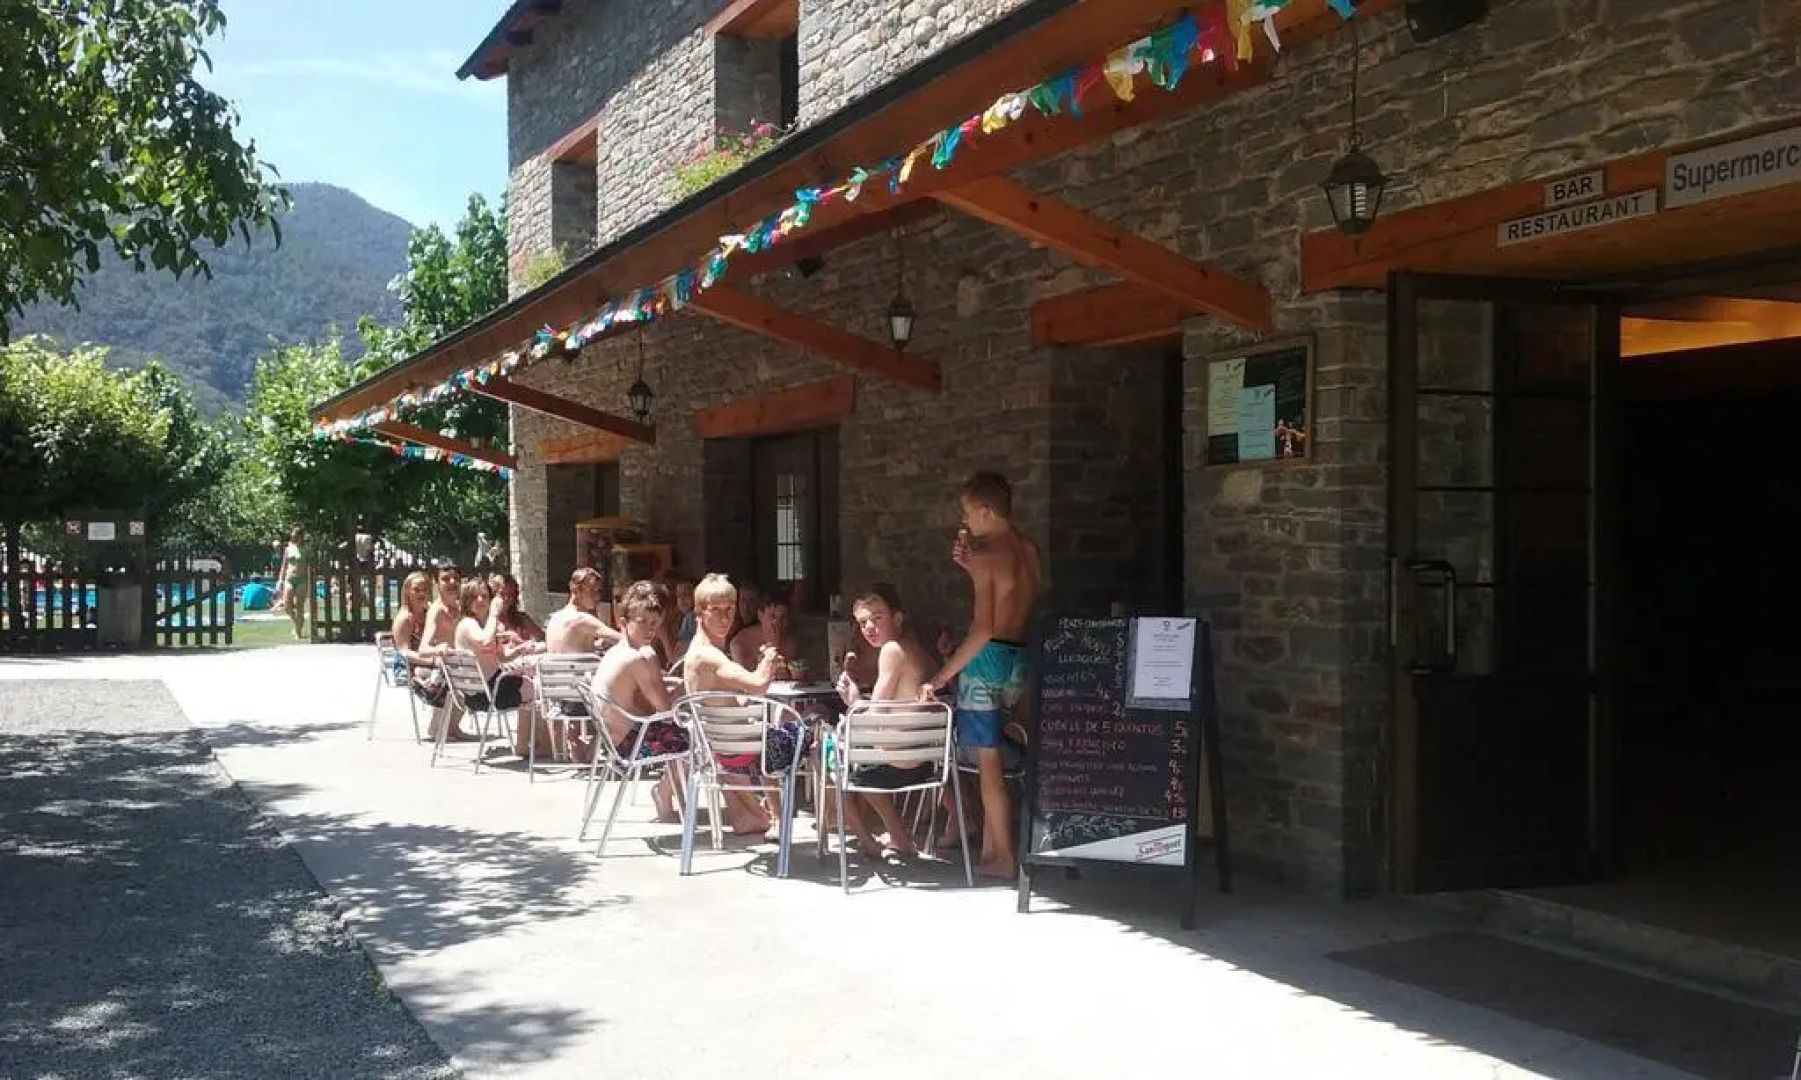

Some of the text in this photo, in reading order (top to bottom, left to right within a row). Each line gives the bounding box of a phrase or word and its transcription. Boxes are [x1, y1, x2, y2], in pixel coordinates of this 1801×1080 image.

[1554, 177, 1593, 201] BAR
[1673, 144, 1800, 192] Supermerc
[1508, 195, 1642, 240] RESTAURANT
